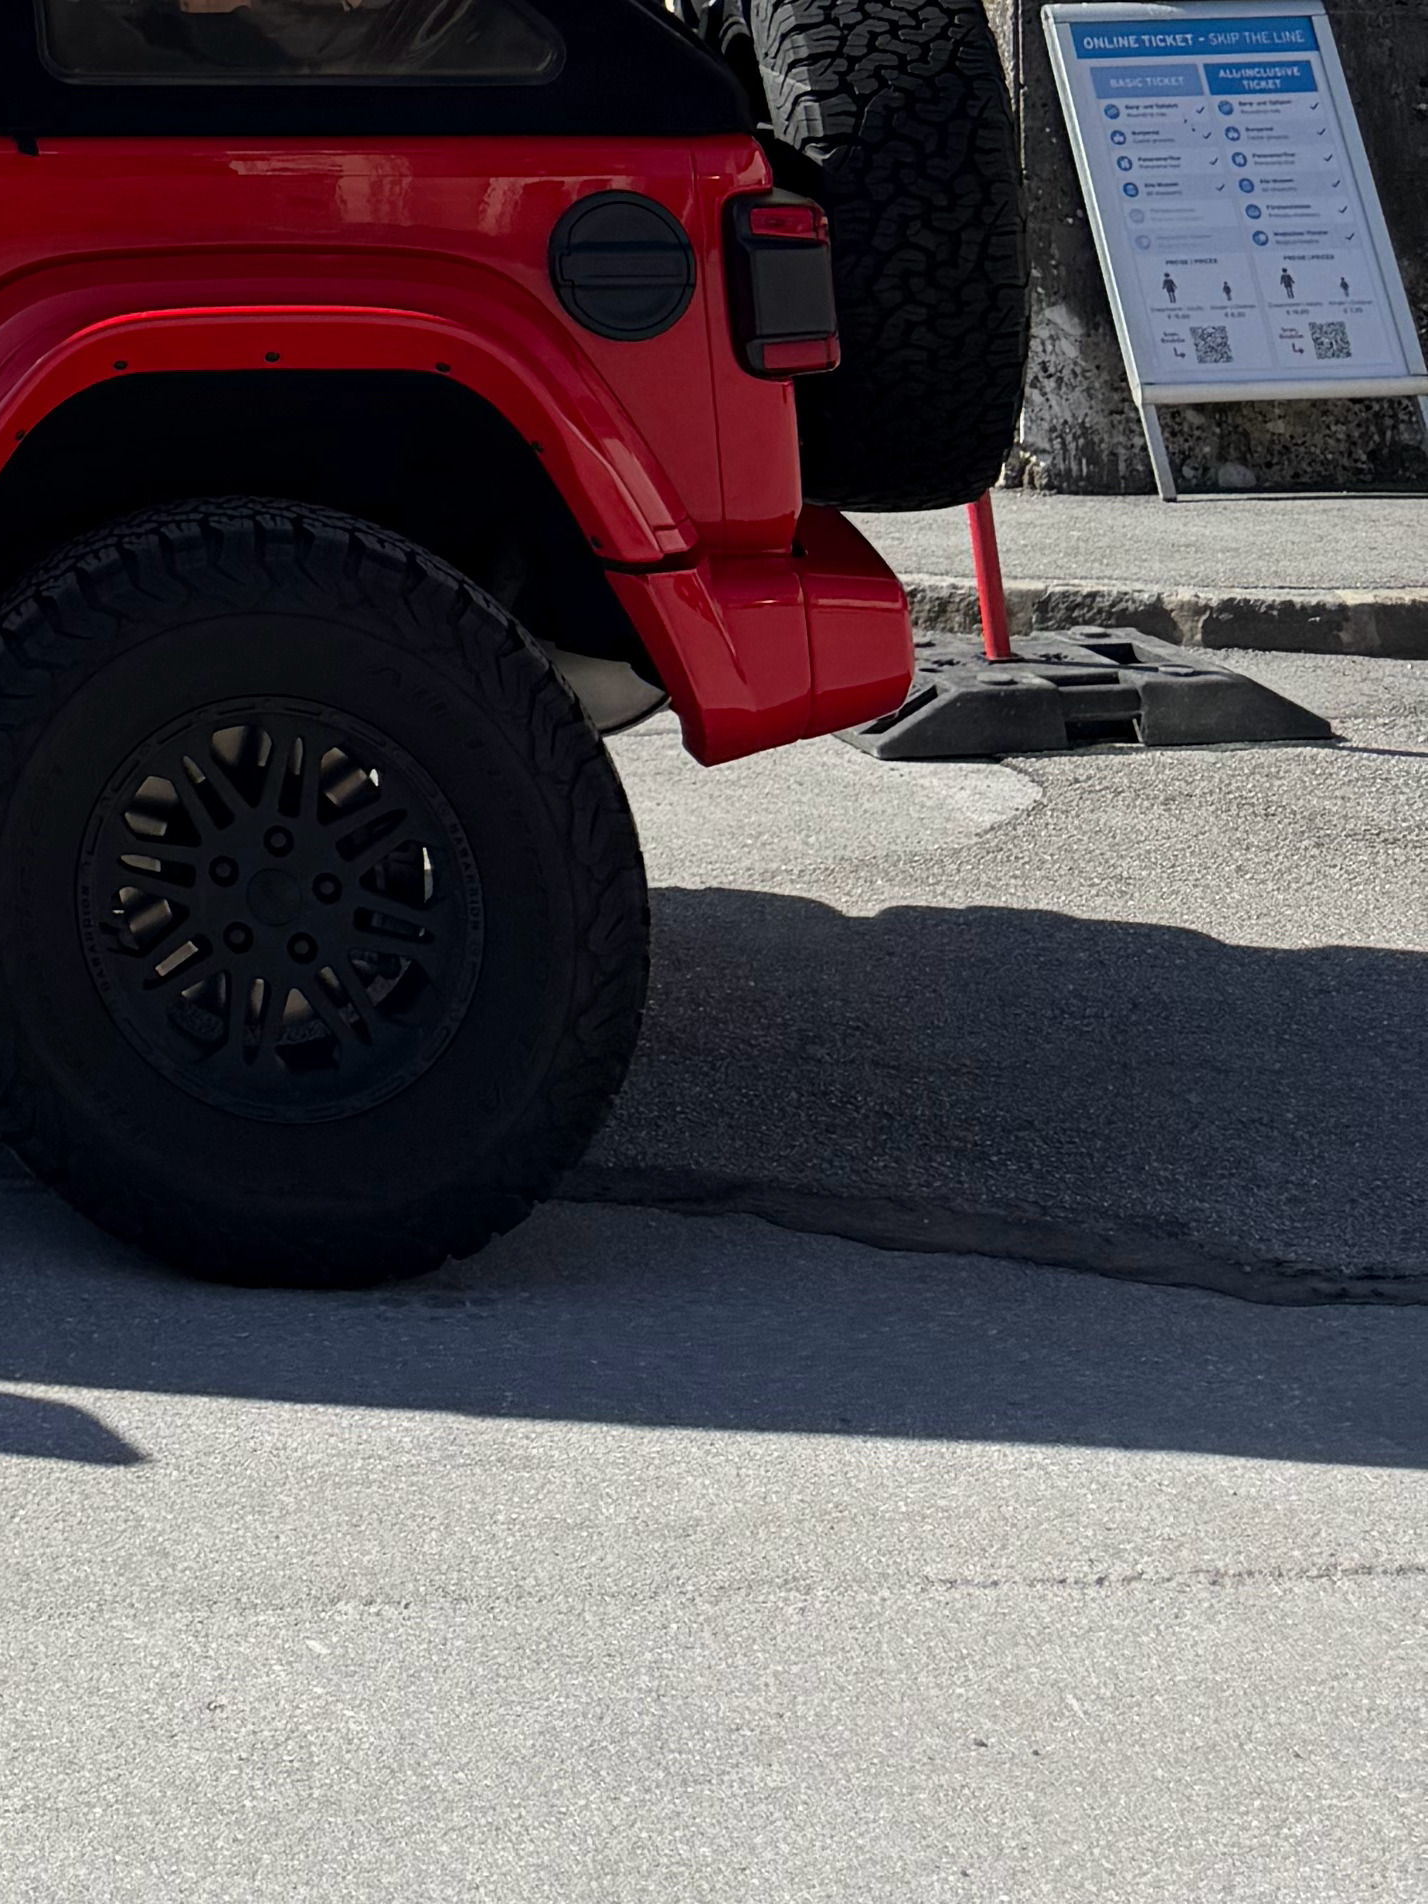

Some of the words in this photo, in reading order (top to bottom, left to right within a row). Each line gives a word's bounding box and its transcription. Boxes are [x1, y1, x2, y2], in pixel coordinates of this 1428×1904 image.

[1083, 35, 1139, 49] ONLINE
[1141, 33, 1193, 47] TICKET
[1208, 32, 1240, 45] SKIP
[1244, 31, 1270, 44] THE
[1273, 30, 1305, 43] LINE
[1109, 78, 1143, 89] BASIC
[1145, 76, 1185, 87] TICKET
[1242, 79, 1282, 90] TICKET
